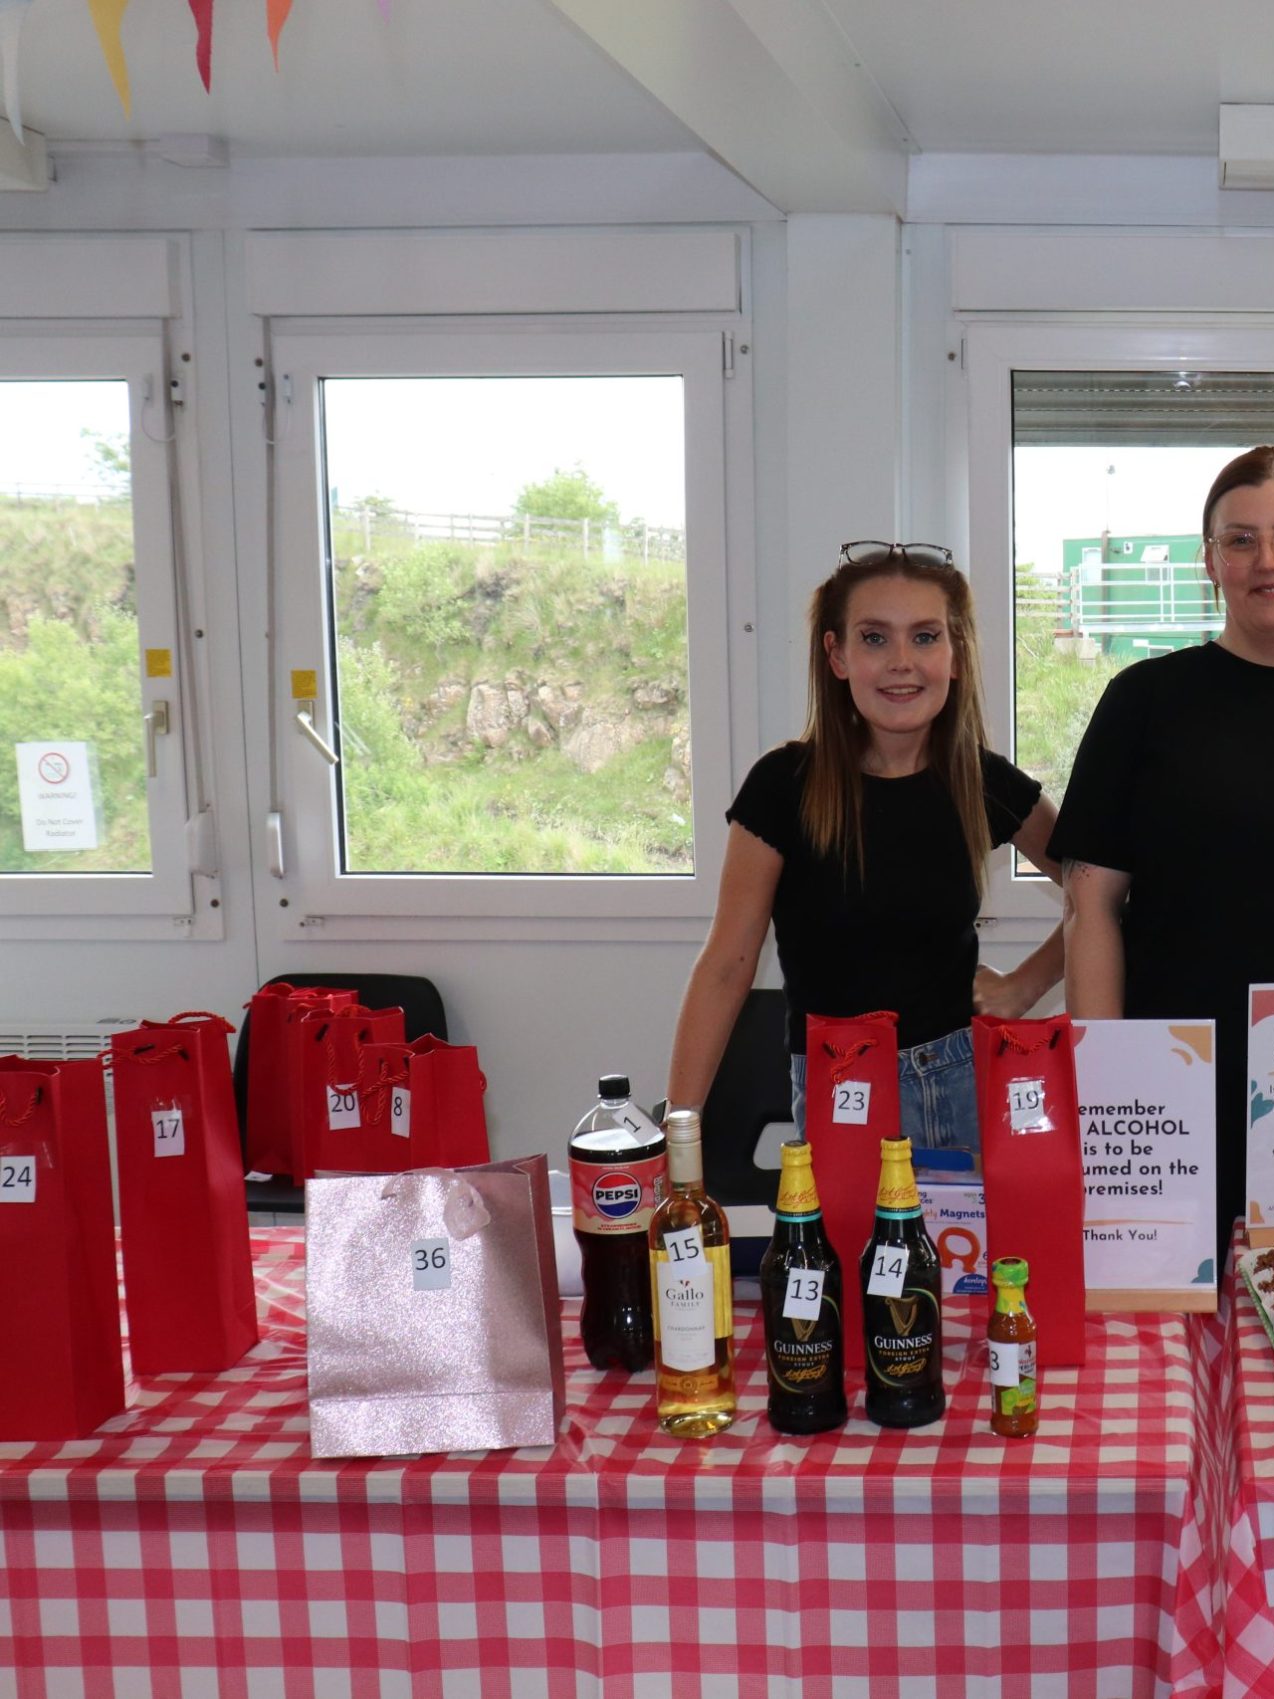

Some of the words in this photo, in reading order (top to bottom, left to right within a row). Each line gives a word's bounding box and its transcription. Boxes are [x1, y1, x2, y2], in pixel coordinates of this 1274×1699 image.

[330, 1093, 356, 1114] 20
[838, 1091, 865, 1111] 23
[1013, 1090, 1039, 1110] 19
[1078, 1099, 1166, 1116] emember
[156, 1119, 180, 1140] 17
[623, 1117, 641, 1133] 1
[1086, 1119, 1190, 1136] ALCOHOL
[1083, 1142, 1097, 1156] is
[1104, 1142, 1123, 1155] to
[1131, 1139, 1153, 1155] be
[1082, 1159, 1131, 1176] umed
[1139, 1165, 1161, 1175] on
[1169, 1159, 1199, 1175] the
[2, 1165, 32, 1188] 24
[595, 1188, 638, 1201] PEPSI
[940, 1208, 985, 1220] Magnets
[1083, 1229, 1123, 1241] Thank
[1128, 1229, 1158, 1241] You!
[669, 1238, 700, 1262] 15
[415, 1247, 446, 1271] 36
[874, 1255, 903, 1279] 14
[665, 1287, 704, 1301] Gallo
[790, 1278, 819, 1301] 13
[773, 1339, 833, 1355] GUINNESS
[874, 1333, 932, 1350] GUINNESS
